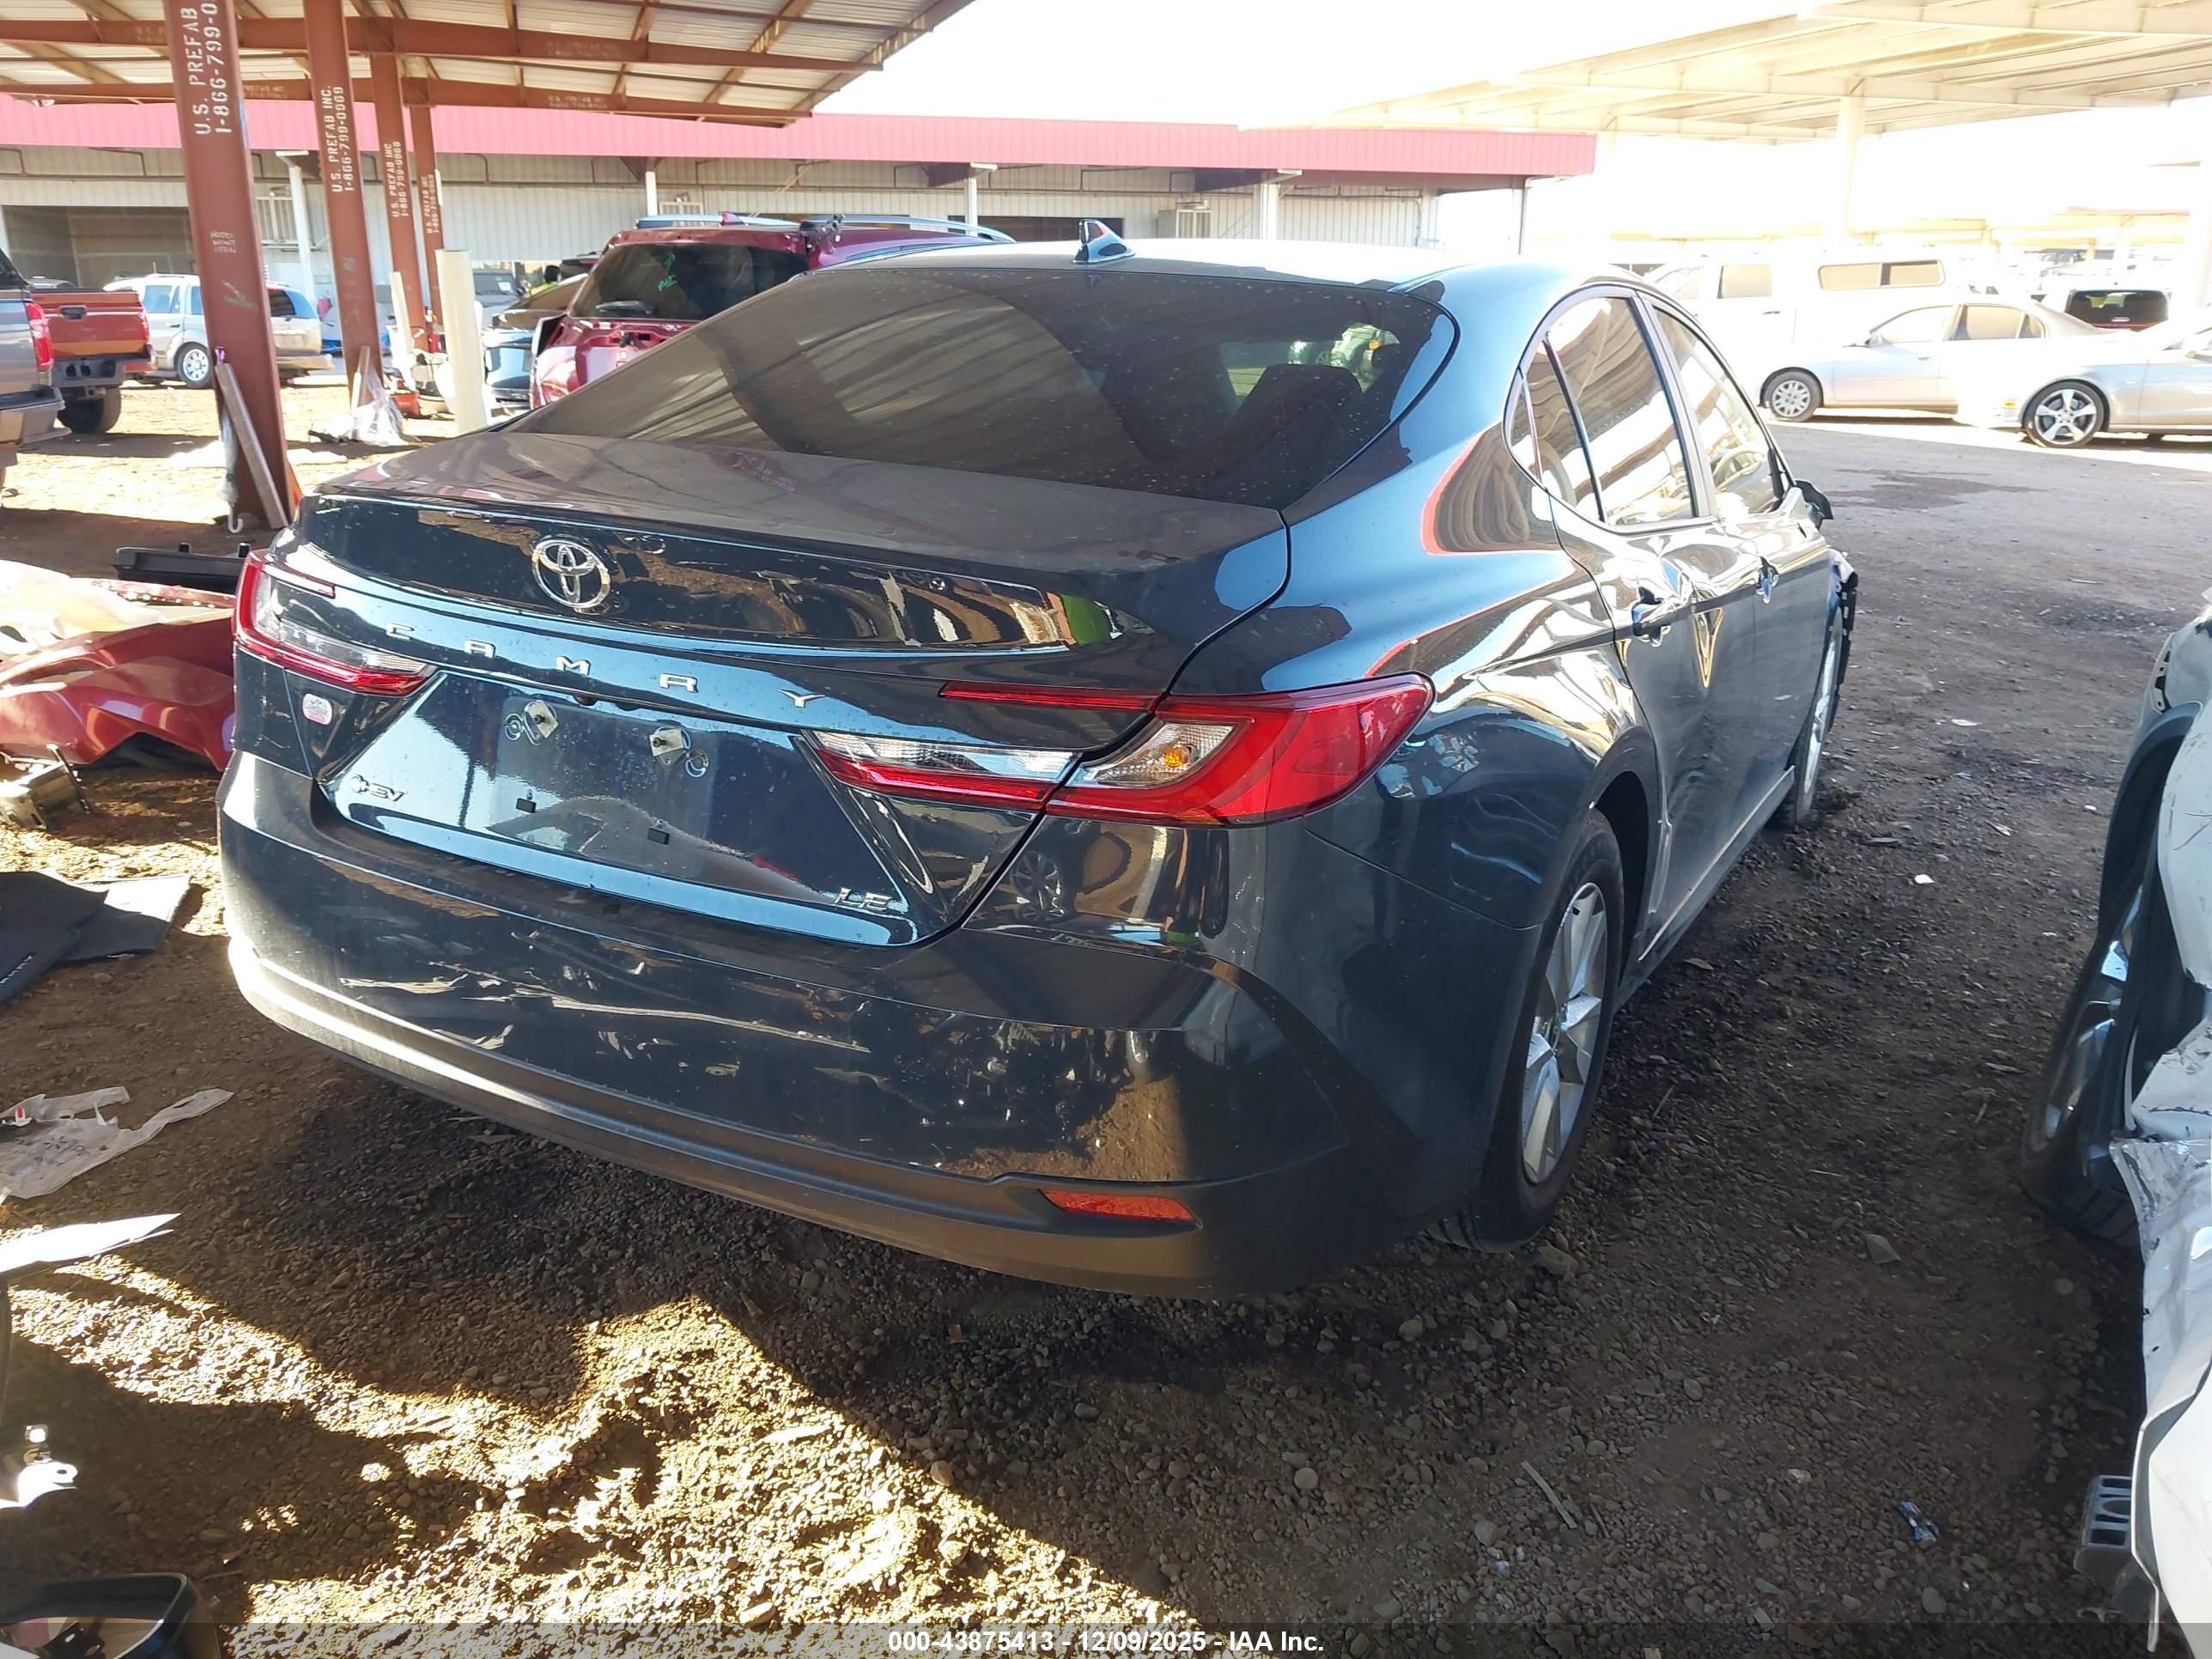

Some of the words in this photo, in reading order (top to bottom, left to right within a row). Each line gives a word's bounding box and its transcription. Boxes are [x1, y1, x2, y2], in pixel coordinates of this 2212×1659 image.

[180, 7, 207, 86] PREFAB
[200, 3, 233, 134] 1-866-799-0
[192, 98, 212, 135] U.S.
[323, 114, 340, 162] PREFAB
[330, 168, 343, 192] U.S.
[386, 161, 397, 196] PREFAB
[385, 622, 827, 709] CAMRY
[834, 886, 893, 911] LE
